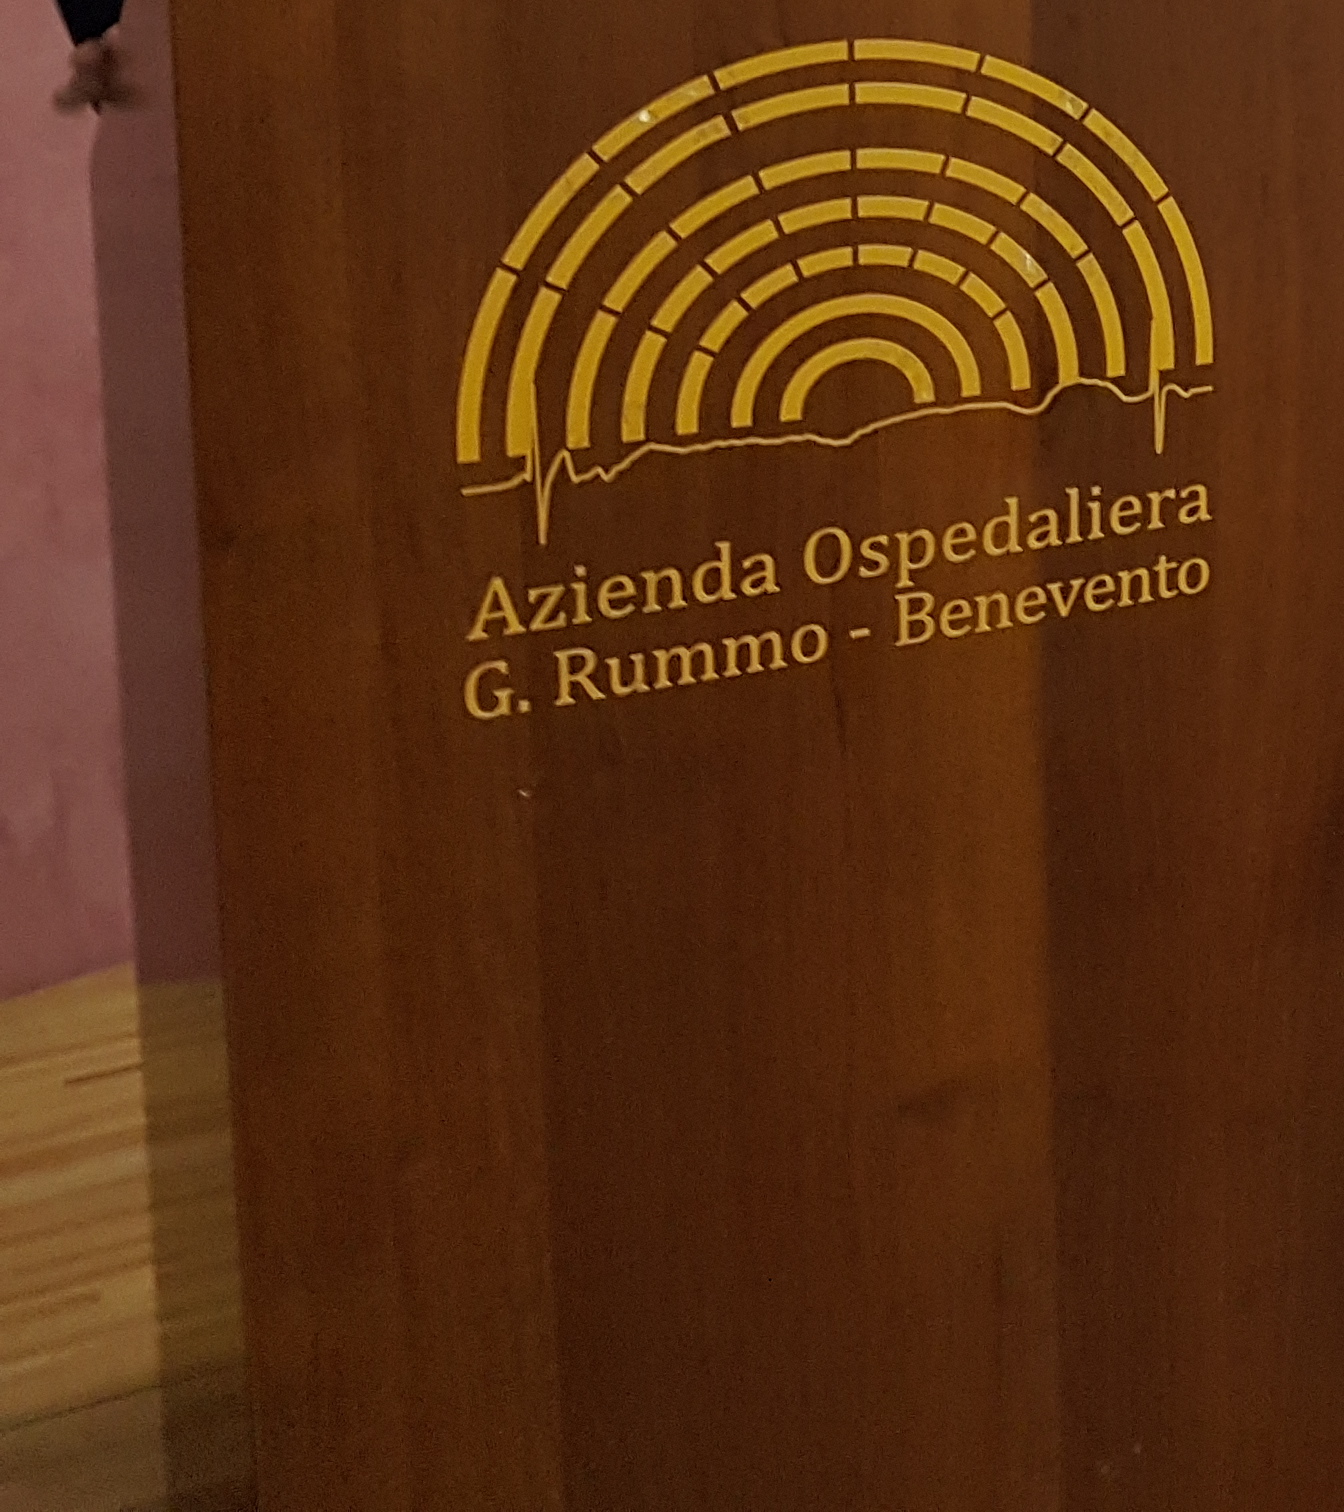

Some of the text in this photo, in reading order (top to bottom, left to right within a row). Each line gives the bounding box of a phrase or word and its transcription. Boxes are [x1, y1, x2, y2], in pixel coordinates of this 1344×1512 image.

[463, 659, 532, 720] G.
[554, 619, 830, 707] Rummo
[893, 553, 1212, 648] Benevento
[465, 479, 1213, 642] Azienda Ospedaliera
